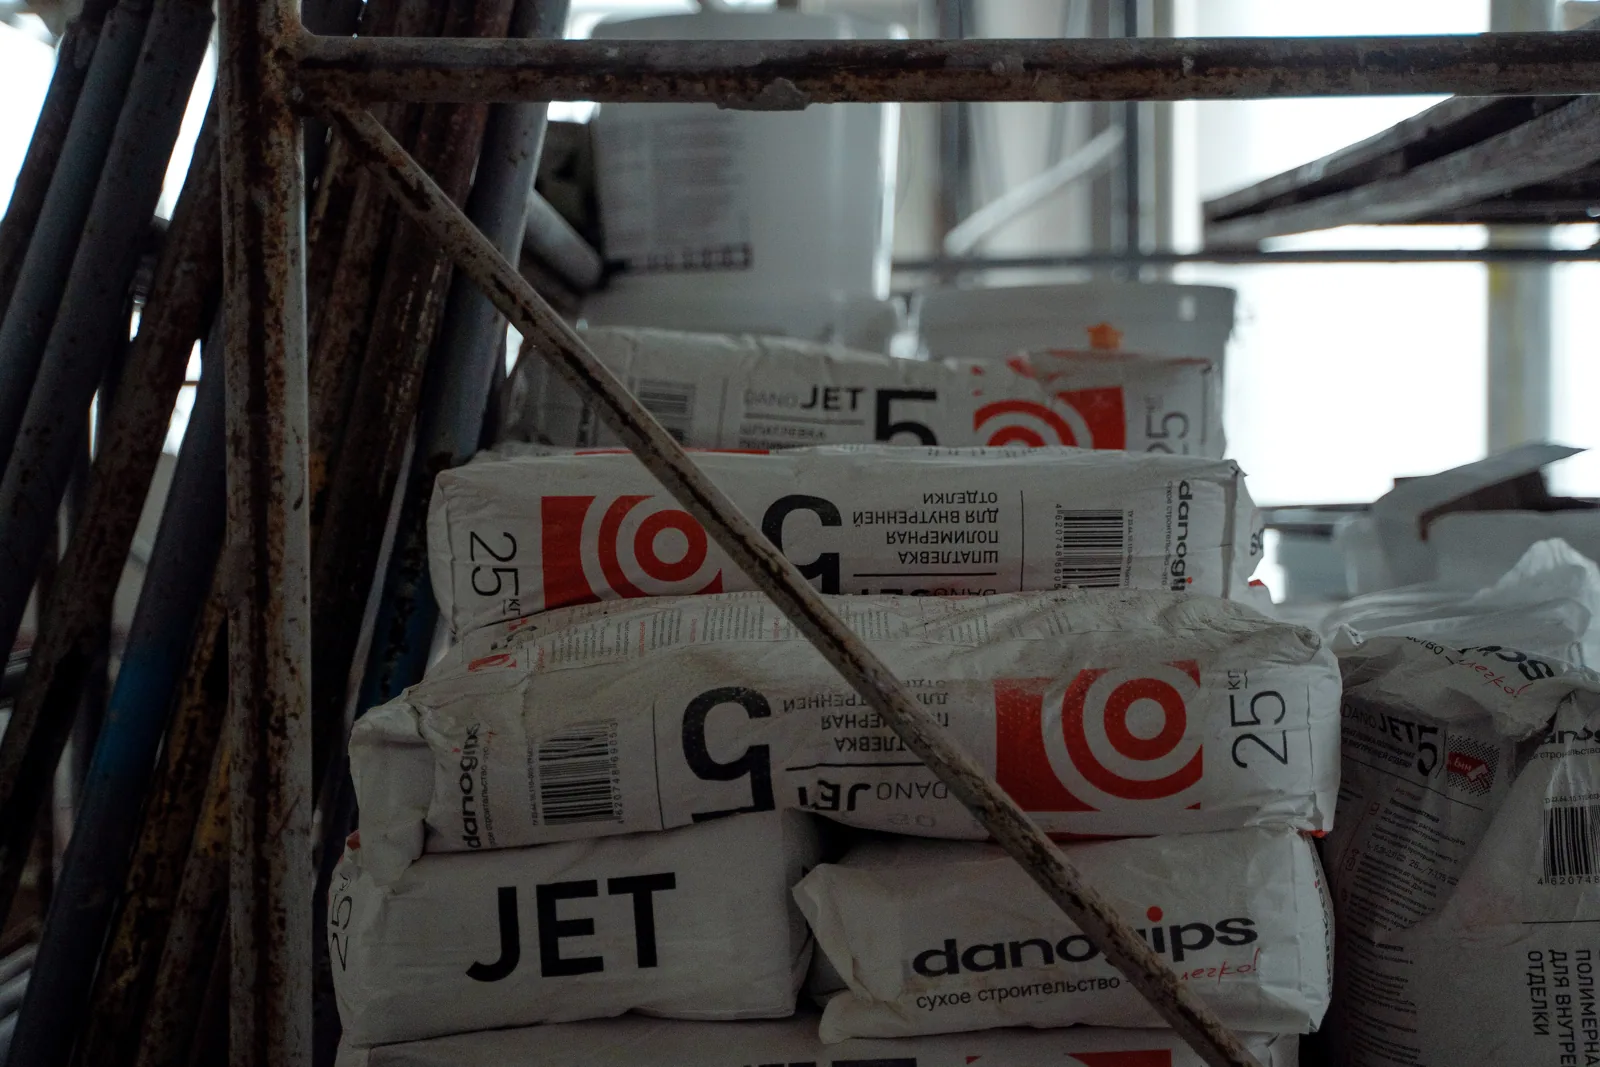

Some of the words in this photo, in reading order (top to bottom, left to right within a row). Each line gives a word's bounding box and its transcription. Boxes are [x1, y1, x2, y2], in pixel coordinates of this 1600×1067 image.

[875, 388, 938, 446] 5
[853, 510, 960, 527] ВНУТРЕННЕЙ
[923, 490, 998, 505] ОТДЕЛКИ
[965, 508, 999, 525] ДЛЯ
[470, 531, 519, 597] 25
[761, 494, 842, 595] 5
[886, 531, 999, 545] ПОЛИМЕРНАЯ
[898, 551, 999, 564] ШПАТЛЕВКА
[681, 686, 776, 823] 5
[834, 736, 906, 753] ТЛЕВКА
[1229, 690, 1288, 769] 25
[1417, 725, 1440, 777] 5
[330, 894, 353, 972] 25
[465, 872, 676, 982] JET
[913, 906, 1259, 977] danoips
[916, 990, 972, 1011] сухое
[977, 976, 1121, 1003] строительство
[1526, 951, 1550, 1036] ОТДЕЛКИ
[1549, 950, 1570, 988] ДЛЯ
[1556, 994, 1578, 1067] ВНУТРЕ
